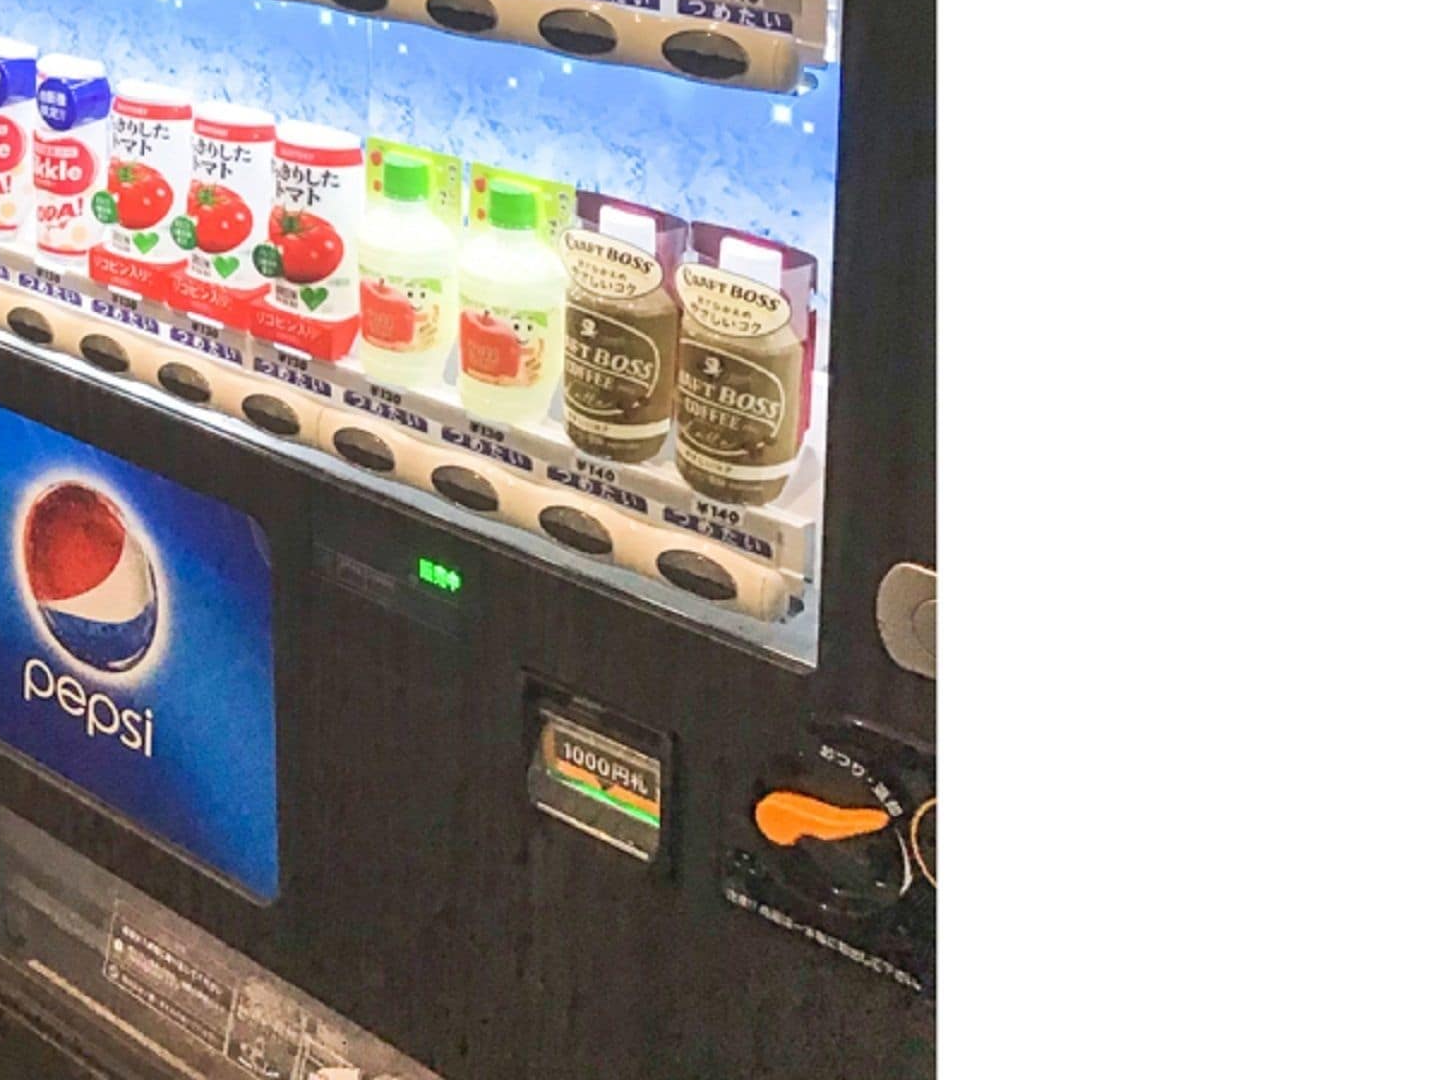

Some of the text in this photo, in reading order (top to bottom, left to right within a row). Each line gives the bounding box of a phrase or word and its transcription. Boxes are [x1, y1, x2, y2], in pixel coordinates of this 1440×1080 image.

[687, 0, 783, 29] つめたい
[565, 231, 655, 275] CRAFT BOSS
[682, 269, 782, 312] CRAFT BOSS
[594, 345, 654, 382] BOSS
[718, 384, 781, 420] BOSS
[576, 459, 615, 483] ¥140
[696, 501, 740, 525] ¥140
[22, 657, 154, 757] pepsi
[563, 742, 649, 795] 1000円札
